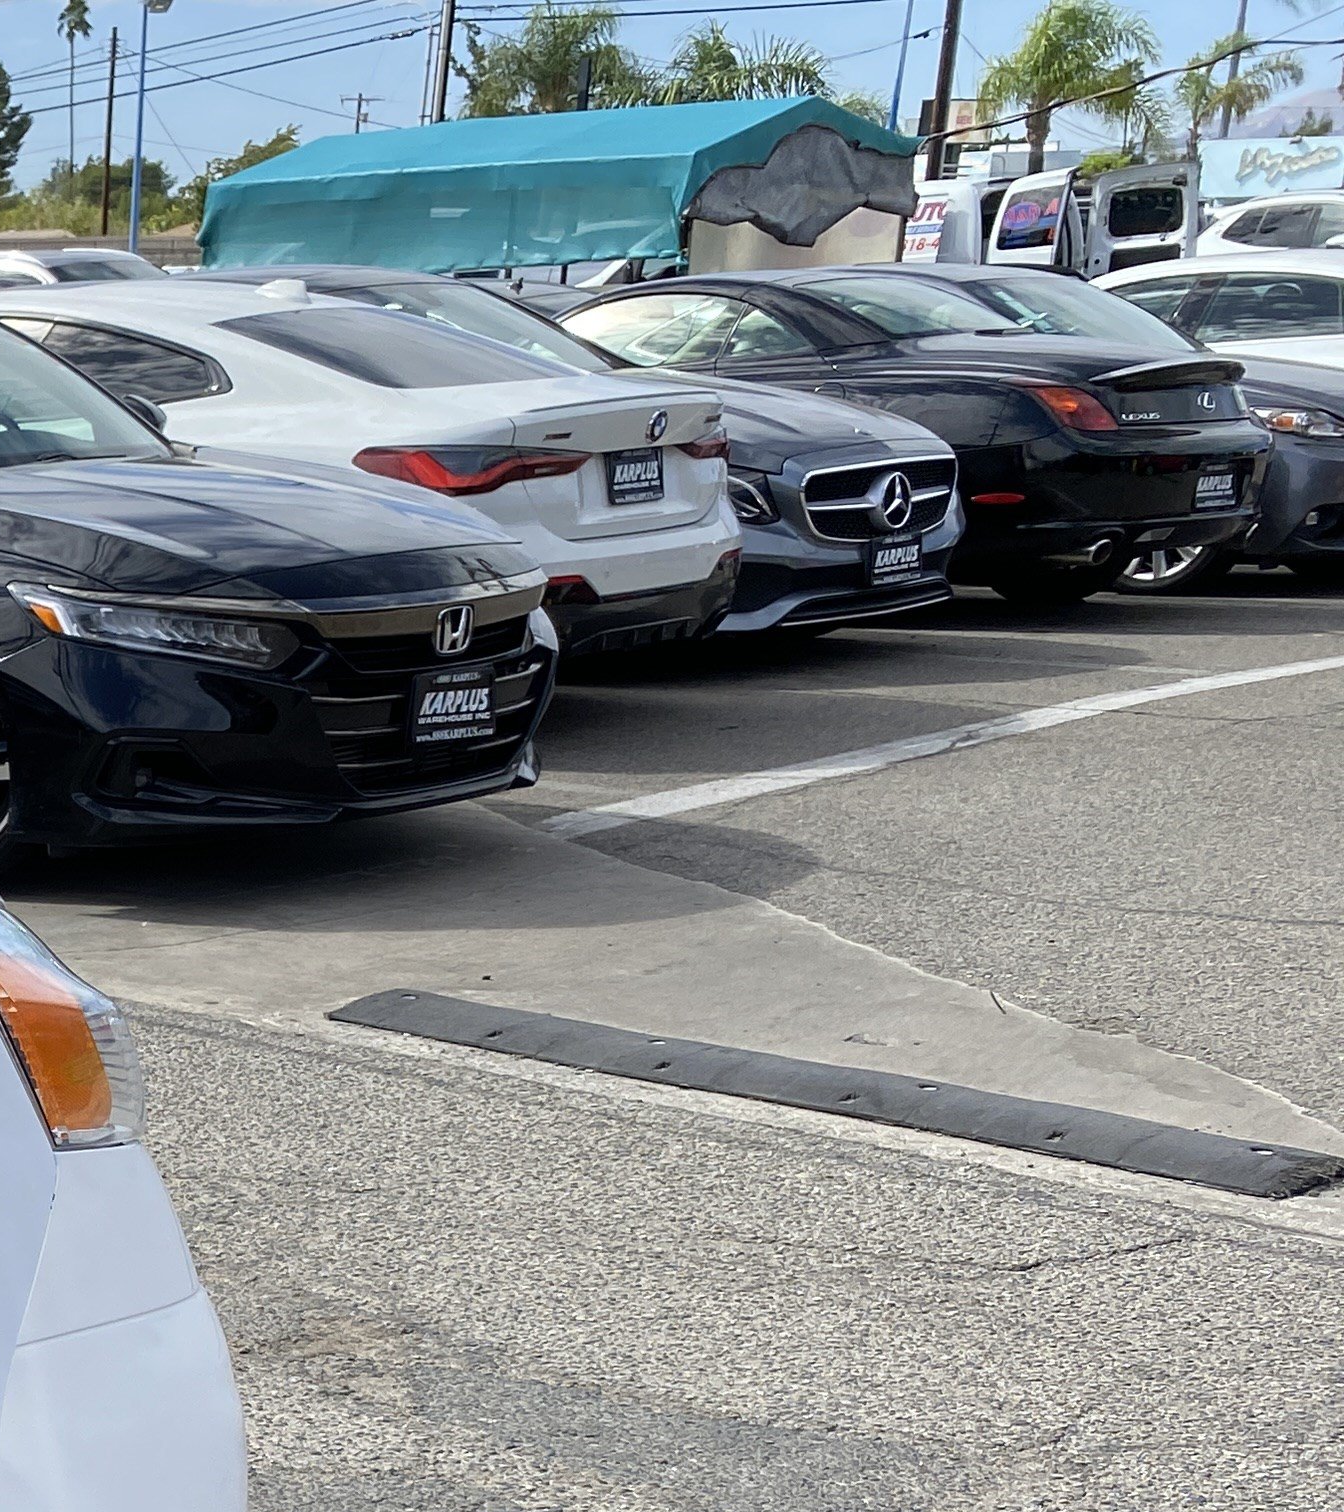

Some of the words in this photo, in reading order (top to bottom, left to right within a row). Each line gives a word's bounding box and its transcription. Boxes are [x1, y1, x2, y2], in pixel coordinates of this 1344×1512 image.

[1121, 412, 1160, 420] LEXUS
[614, 461, 658, 483] KARPLUS
[875, 545, 919, 567] KARPLUS
[419, 688, 489, 716] KARPLUS
[418, 714, 473, 724] WAREHOUSE
